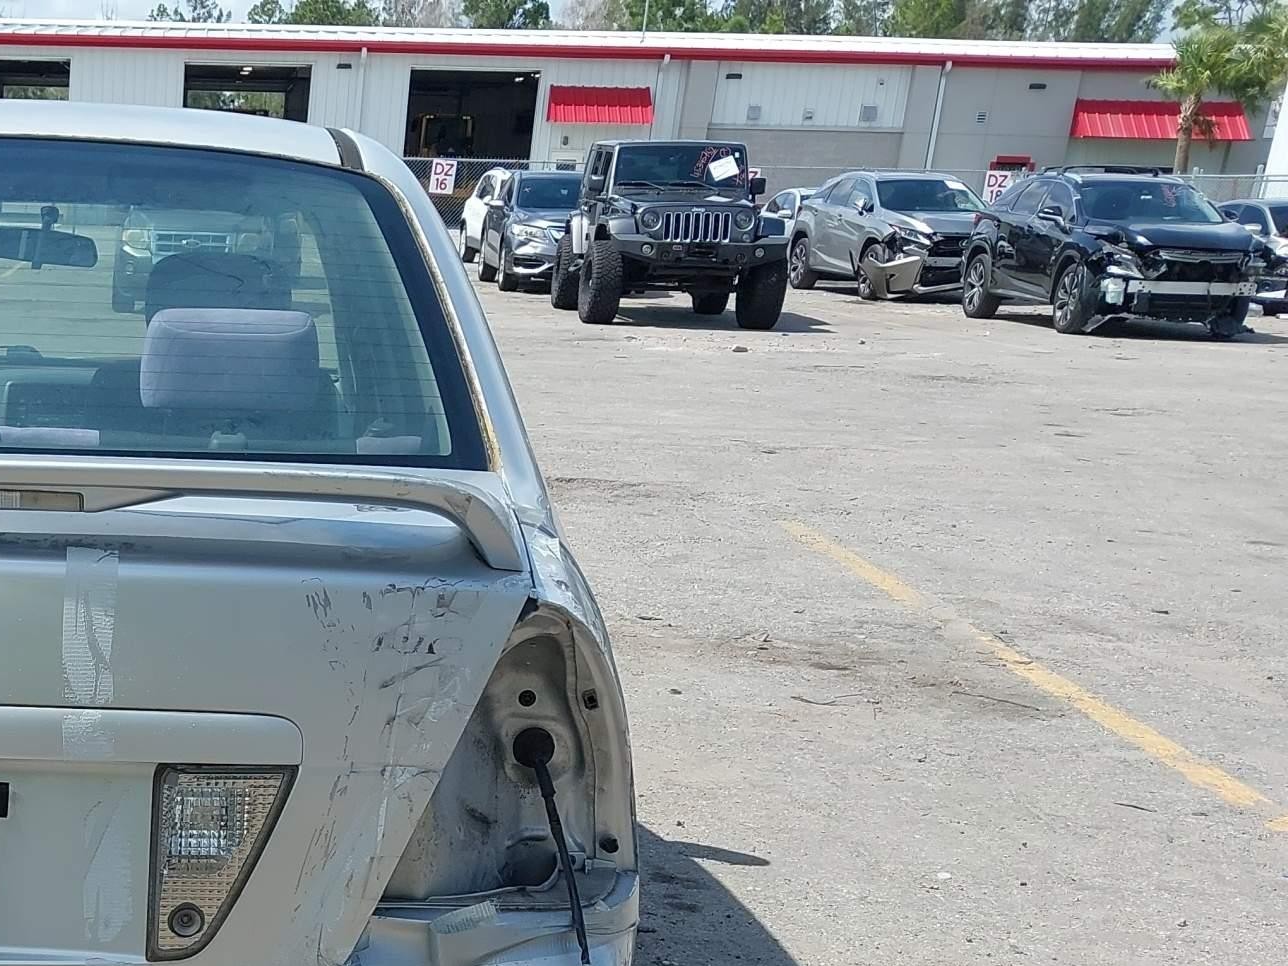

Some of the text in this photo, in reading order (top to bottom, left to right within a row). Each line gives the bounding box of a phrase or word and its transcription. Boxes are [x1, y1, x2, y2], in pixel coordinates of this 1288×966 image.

[433, 162, 455, 176] DZ
[435, 178, 448, 191] 16
[987, 174, 1009, 188] DZ
